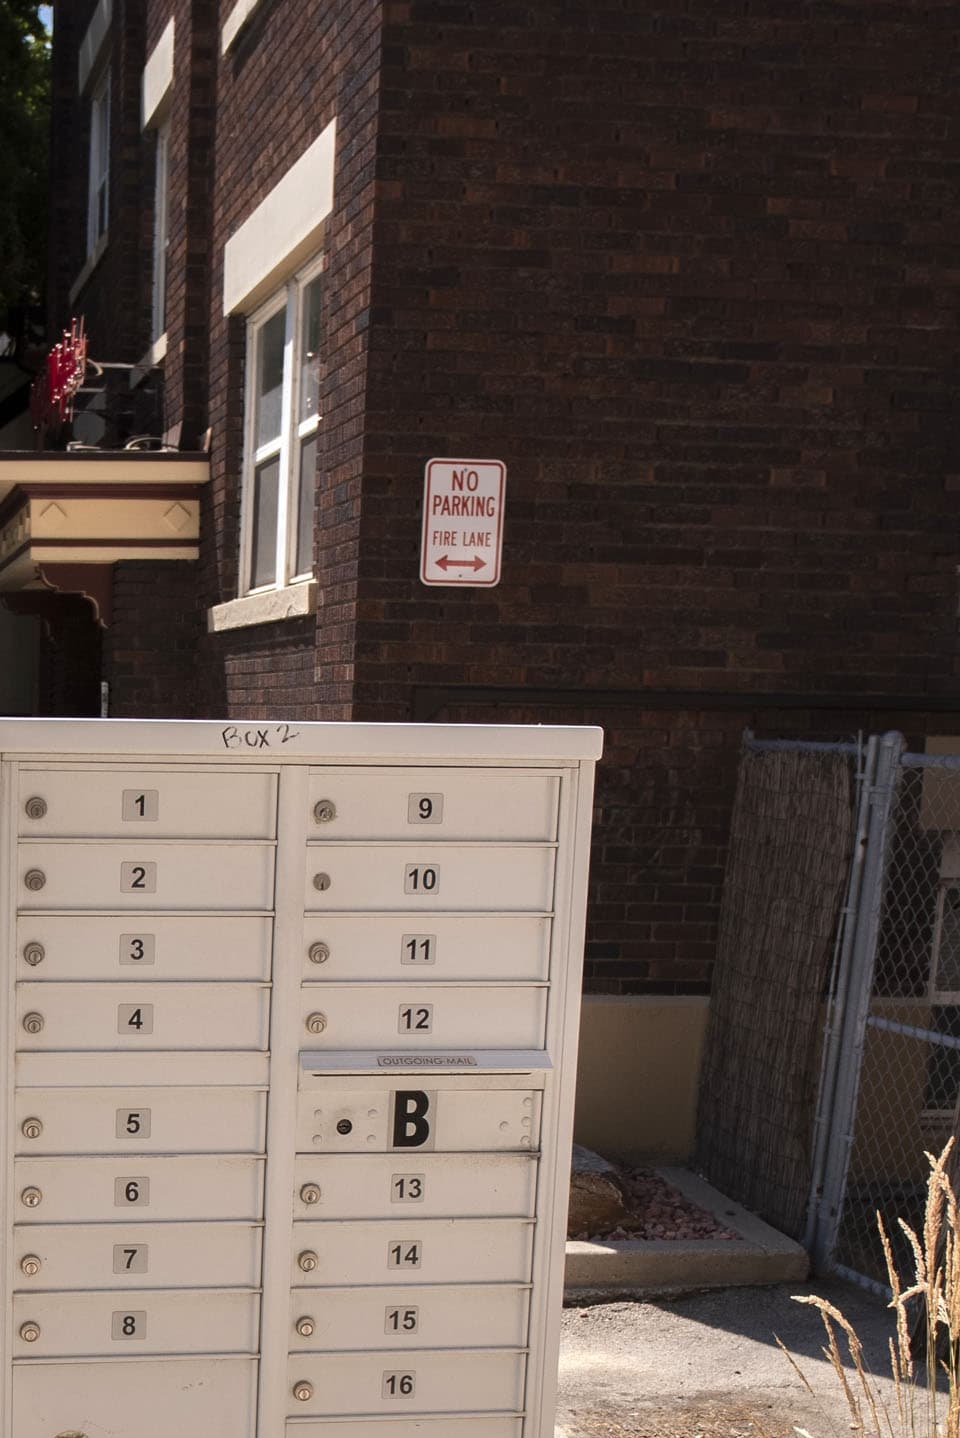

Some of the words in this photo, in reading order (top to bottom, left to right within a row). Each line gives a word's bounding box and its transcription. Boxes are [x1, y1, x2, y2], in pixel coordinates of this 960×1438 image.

[452, 470, 479, 492] NO
[432, 495, 496, 517] PARKING
[432, 530, 457, 546] FIRE
[463, 531, 492, 547] LANE
[135, 794, 145, 817] 1
[418, 798, 433, 820] 9
[131, 866, 146, 888] 2
[408, 868, 436, 890] 10
[130, 939, 144, 960] 3
[406, 939, 430, 960] 11
[128, 1008, 143, 1030] 4
[402, 1008, 429, 1029] 12
[383, 1057, 443, 1065] OUTGOING
[446, 1057, 474, 1065] MAIL
[126, 1113, 140, 1134] 5
[393, 1090, 430, 1148] B
[125, 1181, 139, 1202] 6
[395, 1178, 422, 1199] 13
[123, 1249, 137, 1269] 7
[391, 1245, 419, 1265] 14
[122, 1315, 136, 1336] 8
[389, 1310, 416, 1330] 15
[386, 1375, 413, 1395] 16
